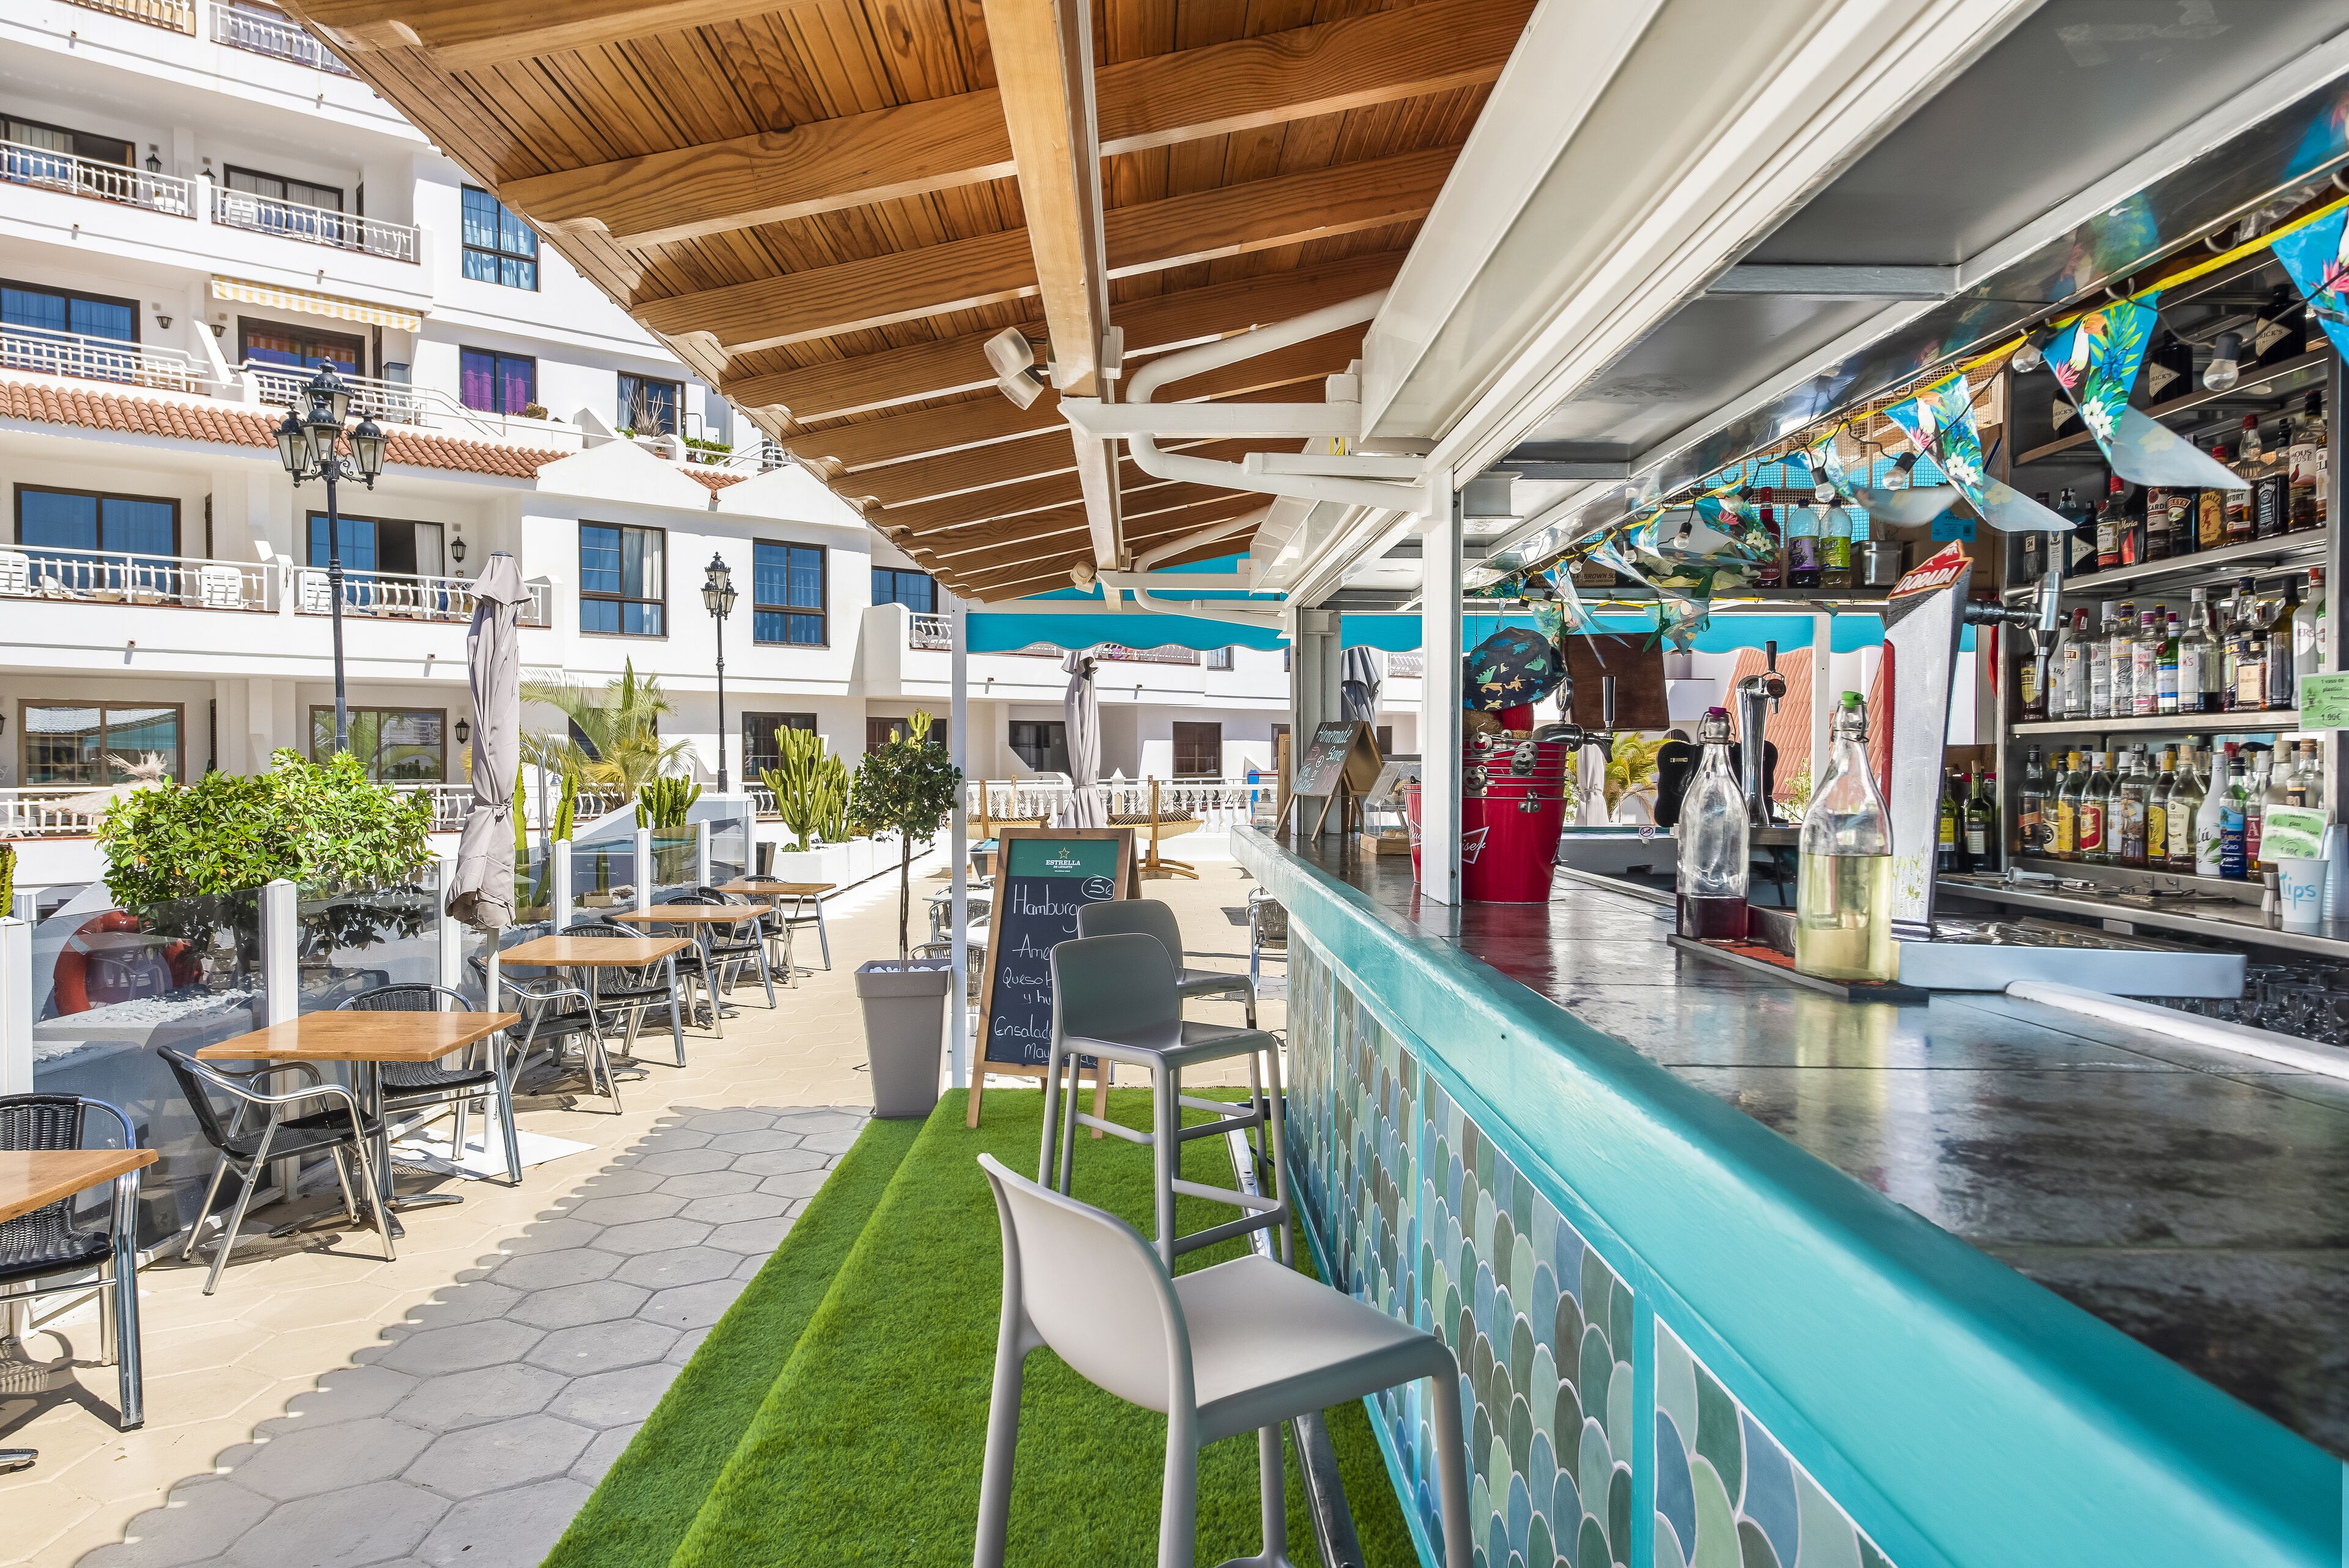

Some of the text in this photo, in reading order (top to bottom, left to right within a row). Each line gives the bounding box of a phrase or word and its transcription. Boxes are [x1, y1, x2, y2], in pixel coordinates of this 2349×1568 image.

[1893, 565, 1959, 593] DORADA
[1316, 723, 1354, 745] Homemade
[1326, 745, 1346, 762] Scone
[1293, 777, 1314, 793] Coffee
[2280, 871, 2317, 910] Tips
[1013, 884, 1080, 933] Hamburg
[1012, 933, 1051, 960] Ame
[1037, 989, 1052, 1005] hu
